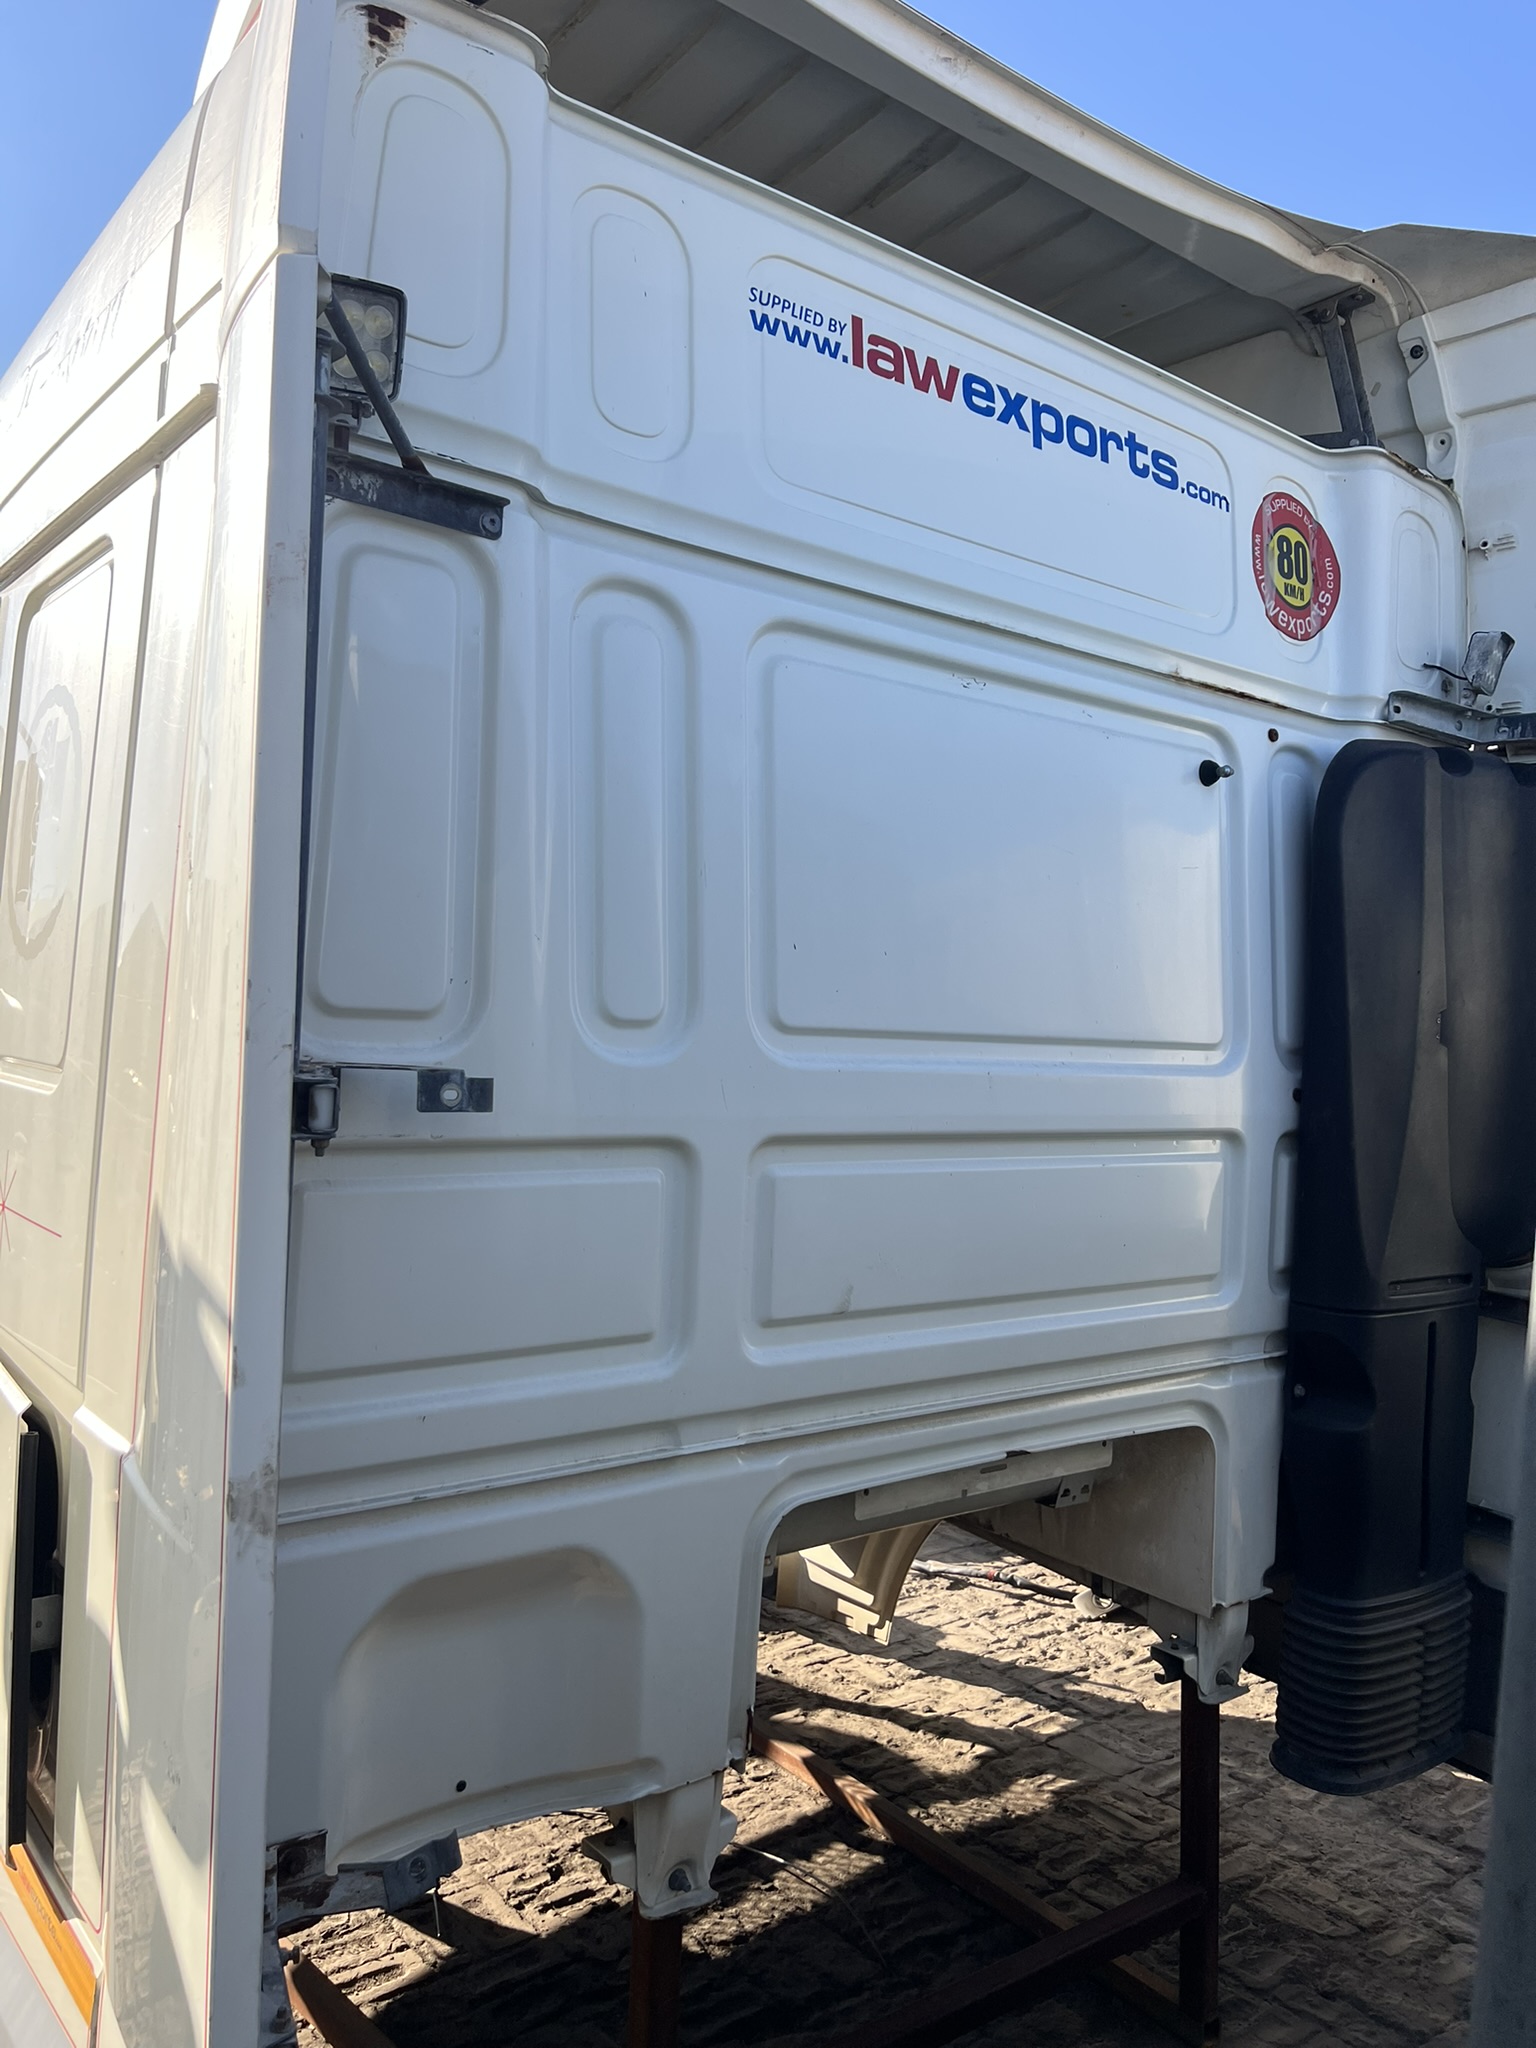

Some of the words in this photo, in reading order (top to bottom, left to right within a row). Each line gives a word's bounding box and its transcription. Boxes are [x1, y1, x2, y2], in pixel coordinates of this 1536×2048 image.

[749, 287, 824, 327] SUPPLIED
[828, 317, 847, 336] BY
[749, 309, 1230, 512] www.lawexports.com
[1276, 534, 1308, 586] 80
[1283, 582, 1305, 602] KM/H
